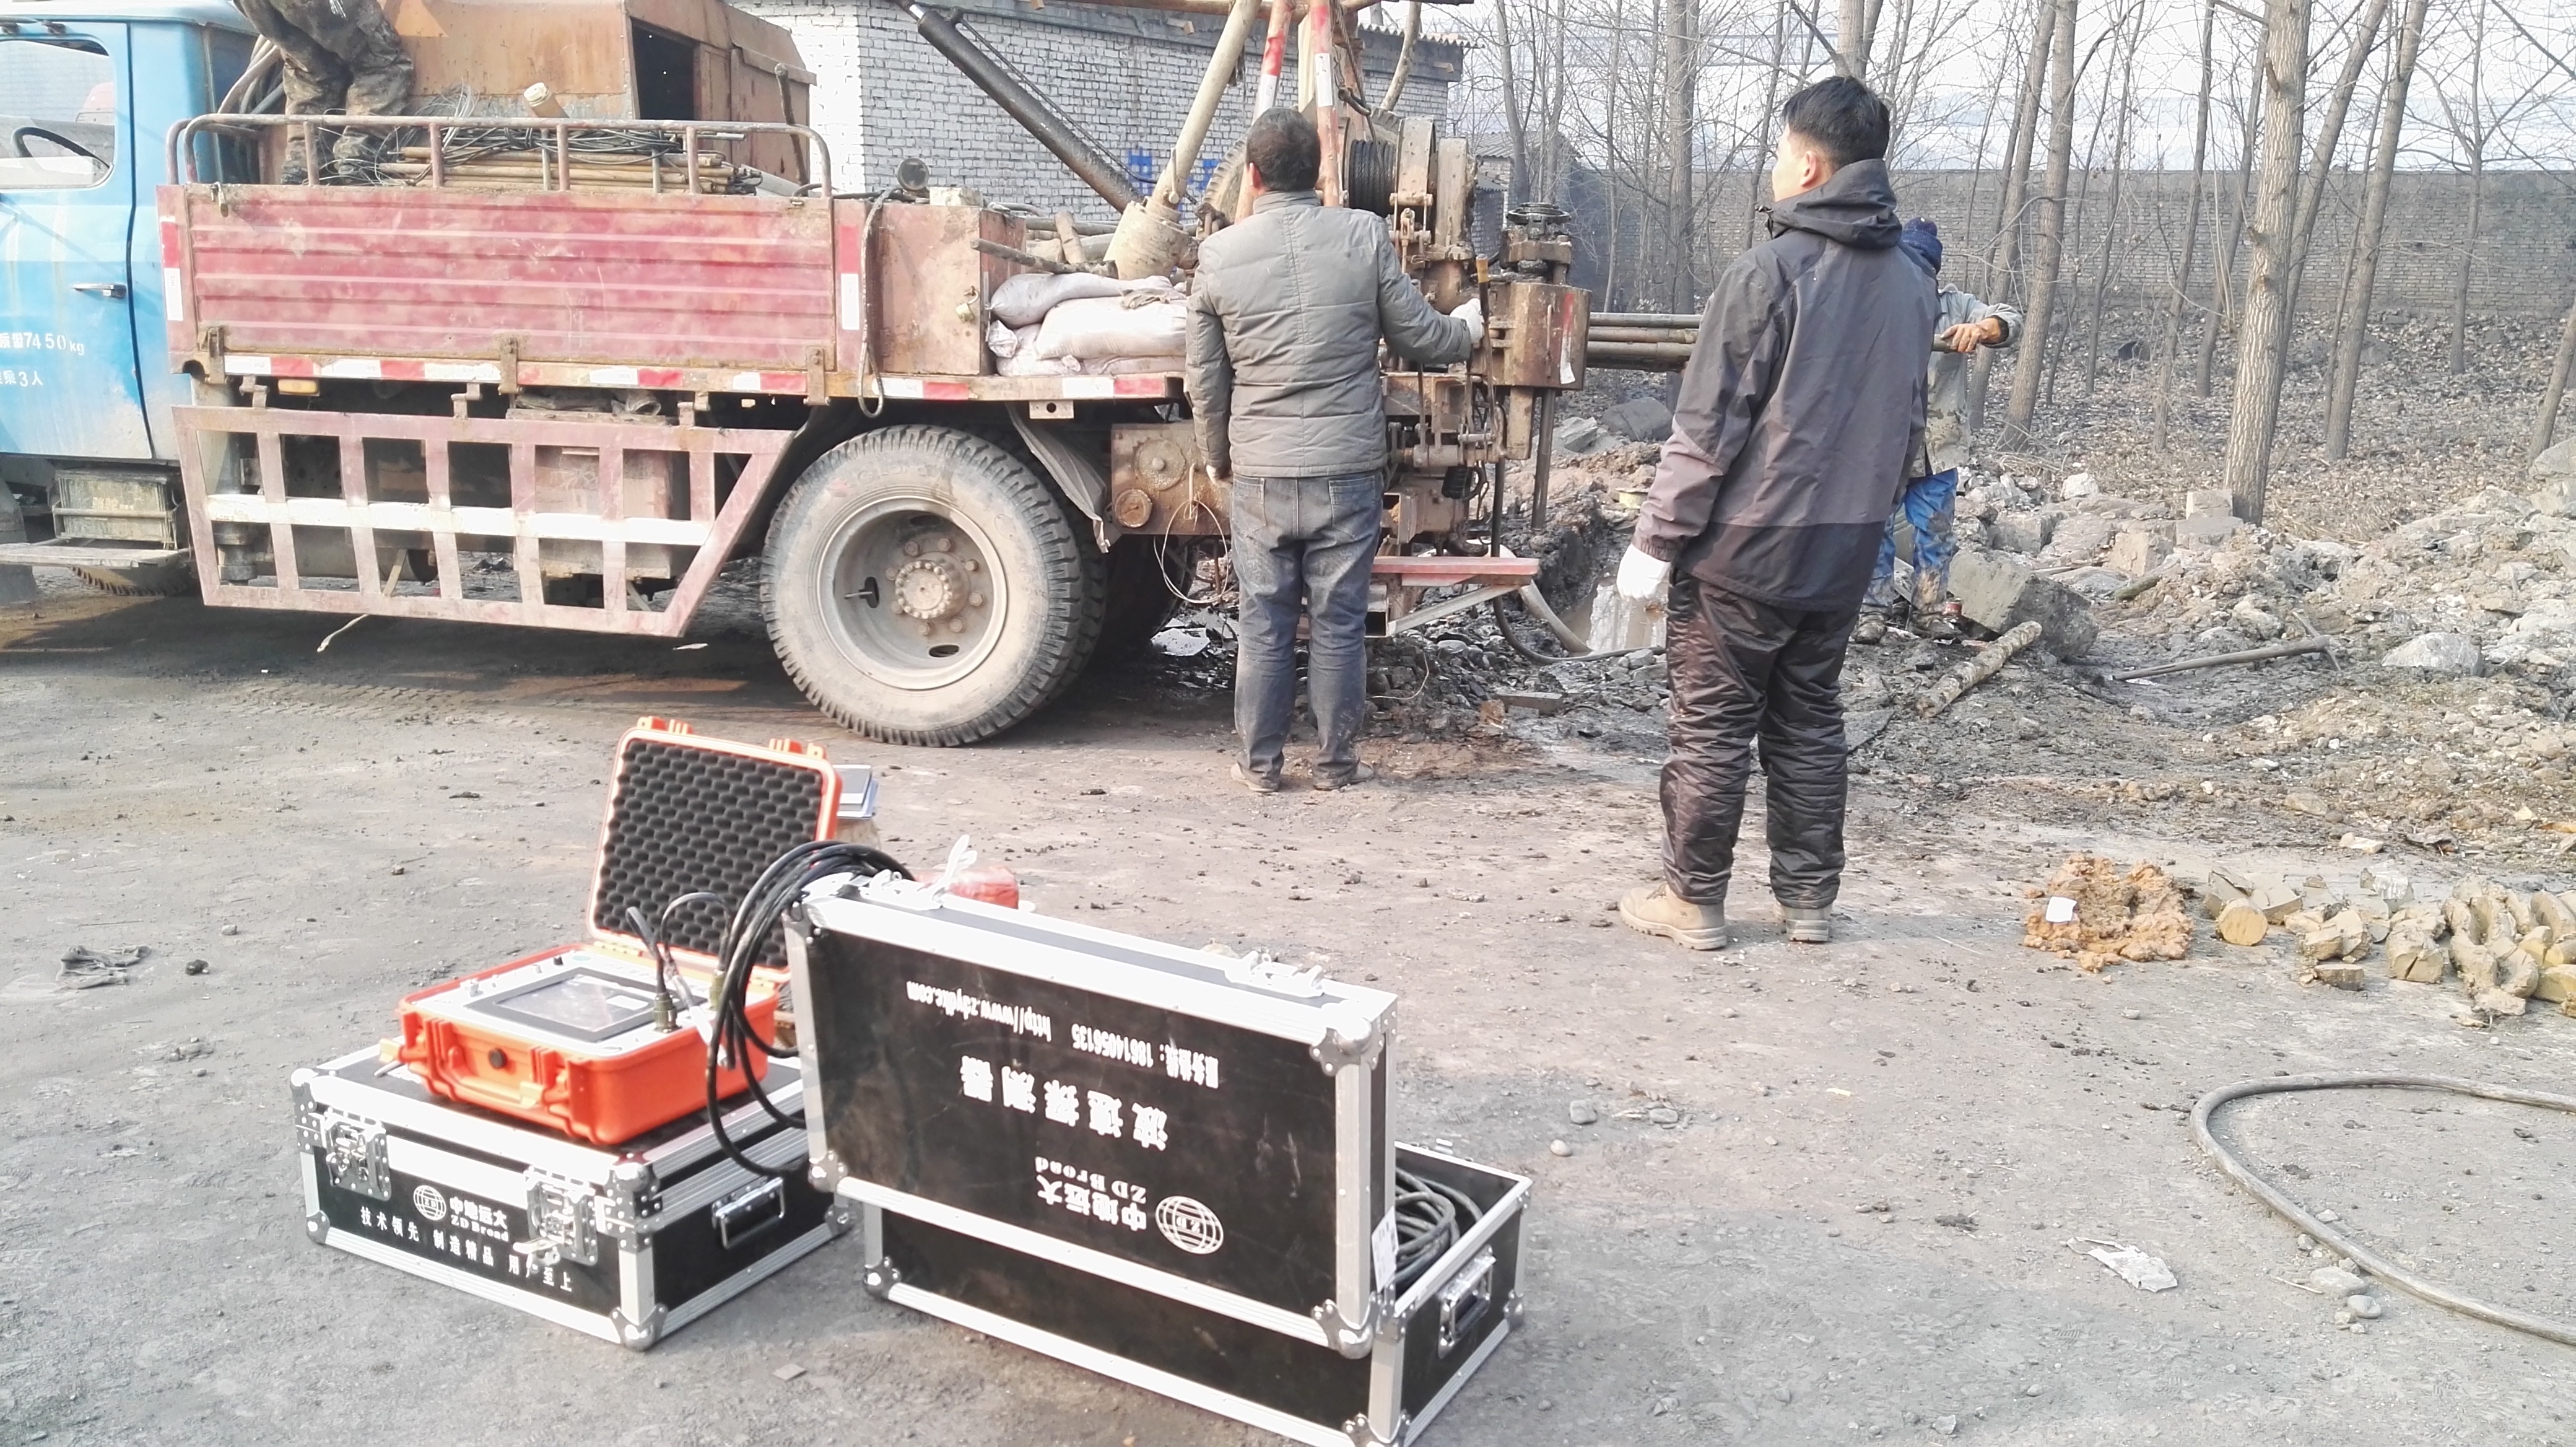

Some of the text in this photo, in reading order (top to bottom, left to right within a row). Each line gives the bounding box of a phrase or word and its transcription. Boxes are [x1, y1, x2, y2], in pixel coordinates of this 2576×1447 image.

[0, 370, 44, 387] 乘3人
[959, 1055, 1167, 1150] 波速探测器
[1034, 1156, 1146, 1204] ZD Broad
[1035, 1174, 1146, 1231] 中地远大
[360, 1206, 419, 1241] 技术领先
[433, 1229, 494, 1266] 制造精品
[450, 1196, 508, 1230] 中地远大
[451, 1215, 509, 1242] ZD Broad
